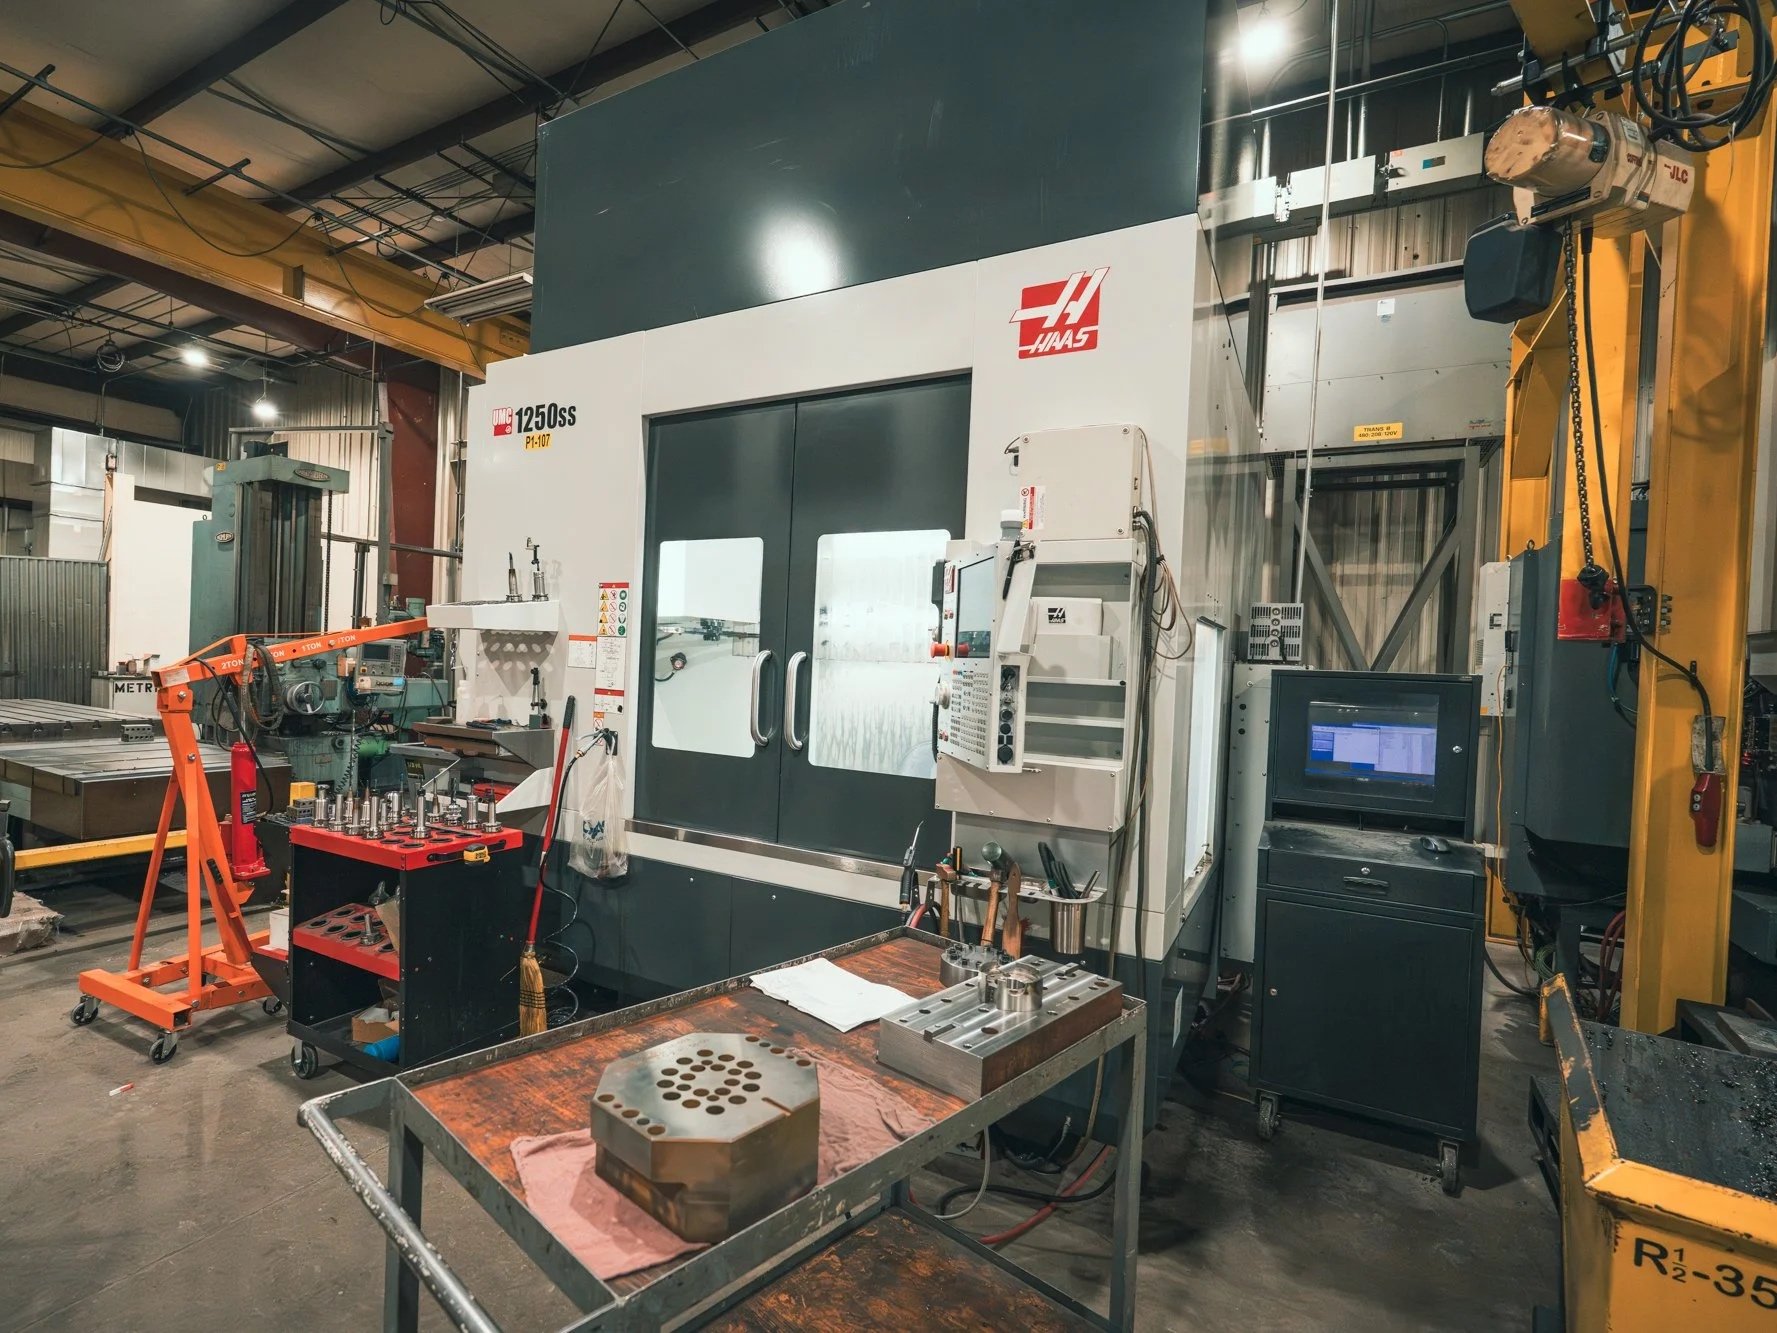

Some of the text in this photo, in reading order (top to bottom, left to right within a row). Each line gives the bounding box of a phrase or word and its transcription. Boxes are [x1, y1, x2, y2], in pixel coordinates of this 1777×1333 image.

[1019, 325, 1098, 354] HAAS
[493, 407, 512, 426] UMC
[525, 433, 551, 449] P1-107
